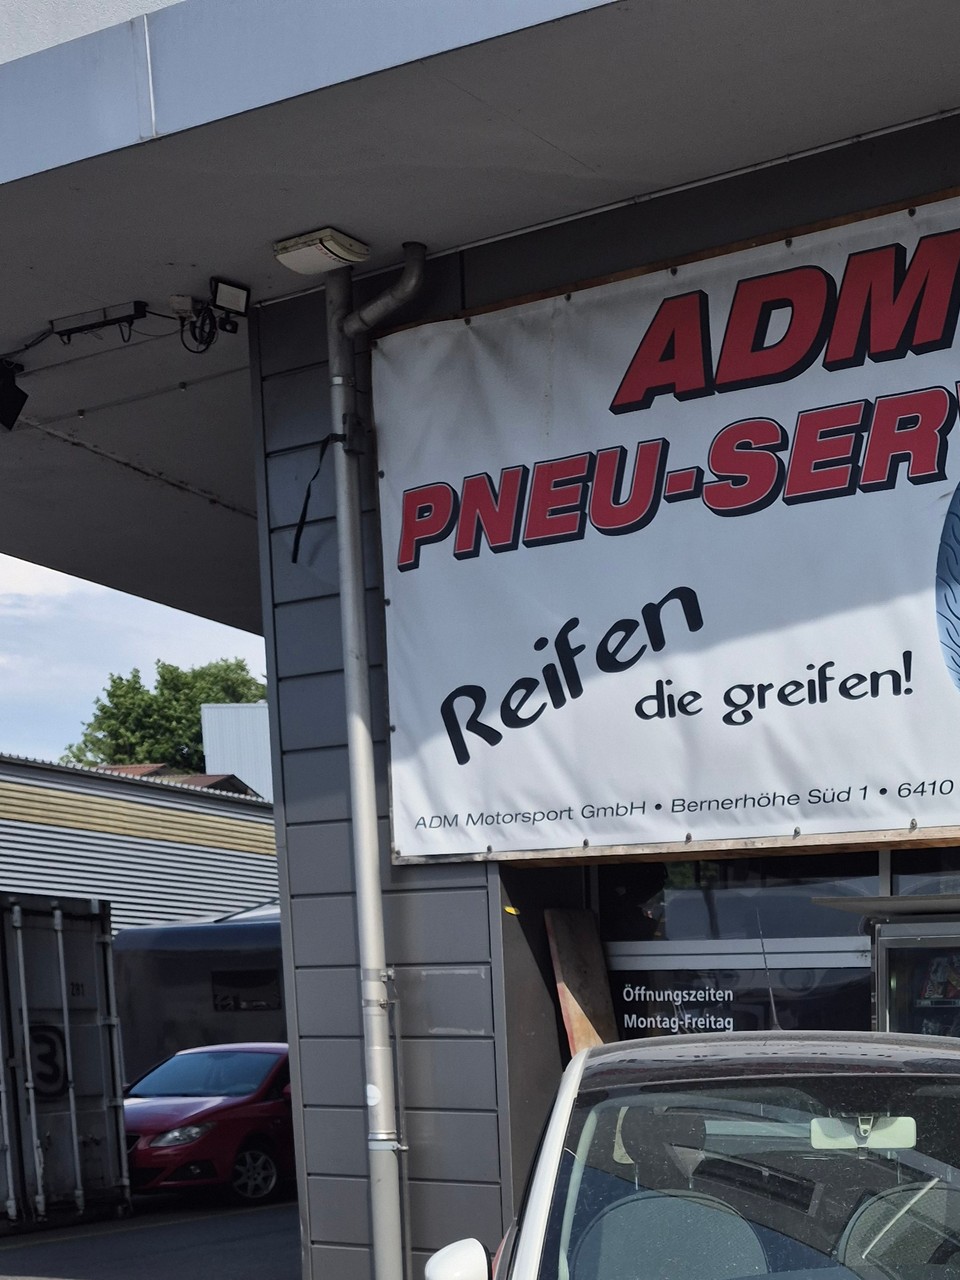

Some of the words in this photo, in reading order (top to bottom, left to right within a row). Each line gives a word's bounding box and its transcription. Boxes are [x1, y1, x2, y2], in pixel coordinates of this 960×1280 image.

[440, 586, 704, 765] Reifen
[634, 679, 703, 720] die
[722, 650, 913, 726] greifen!
[415, 813, 459, 830] ADM
[465, 805, 574, 827] Motorsport
[580, 801, 647, 819] GmbH
[670, 791, 801, 814] Bernerhöhe
[807, 786, 852, 805] Süd
[858, 785, 869, 801] 1
[897, 778, 954, 799] 6410
[622, 983, 734, 1006] Öffnungszeiten
[623, 1013, 734, 1033] Montag-Freitag
